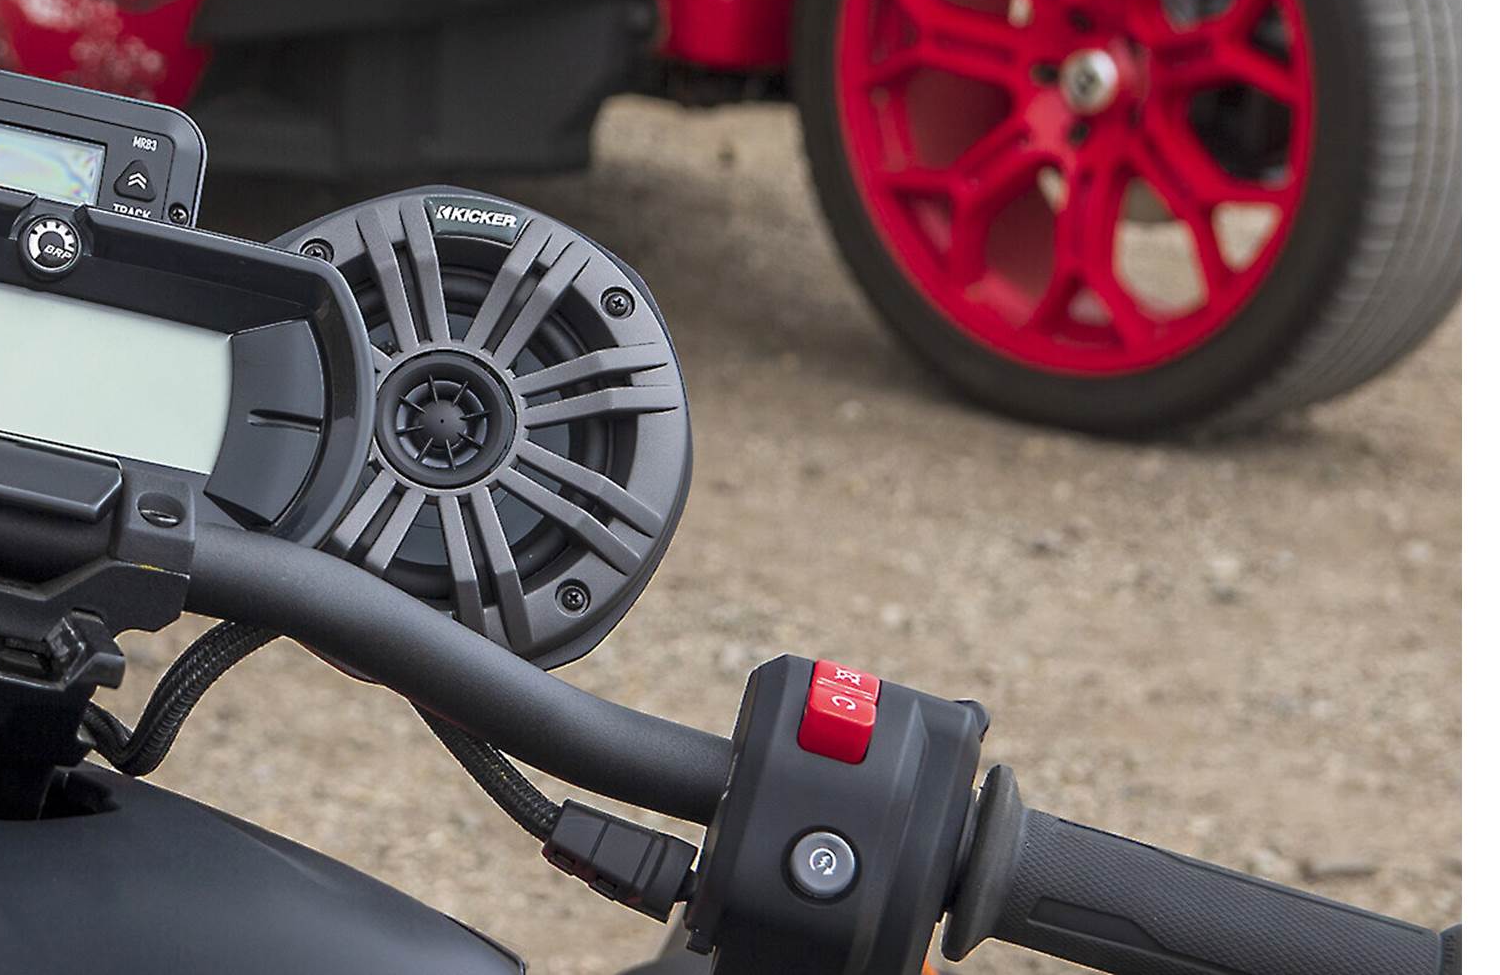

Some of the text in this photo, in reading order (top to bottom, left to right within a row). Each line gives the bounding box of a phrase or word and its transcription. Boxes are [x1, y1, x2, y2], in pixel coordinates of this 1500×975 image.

[112, 203, 151, 218] TRACK
[450, 206, 517, 228] KICKER
[43, 244, 73, 259] BRP
